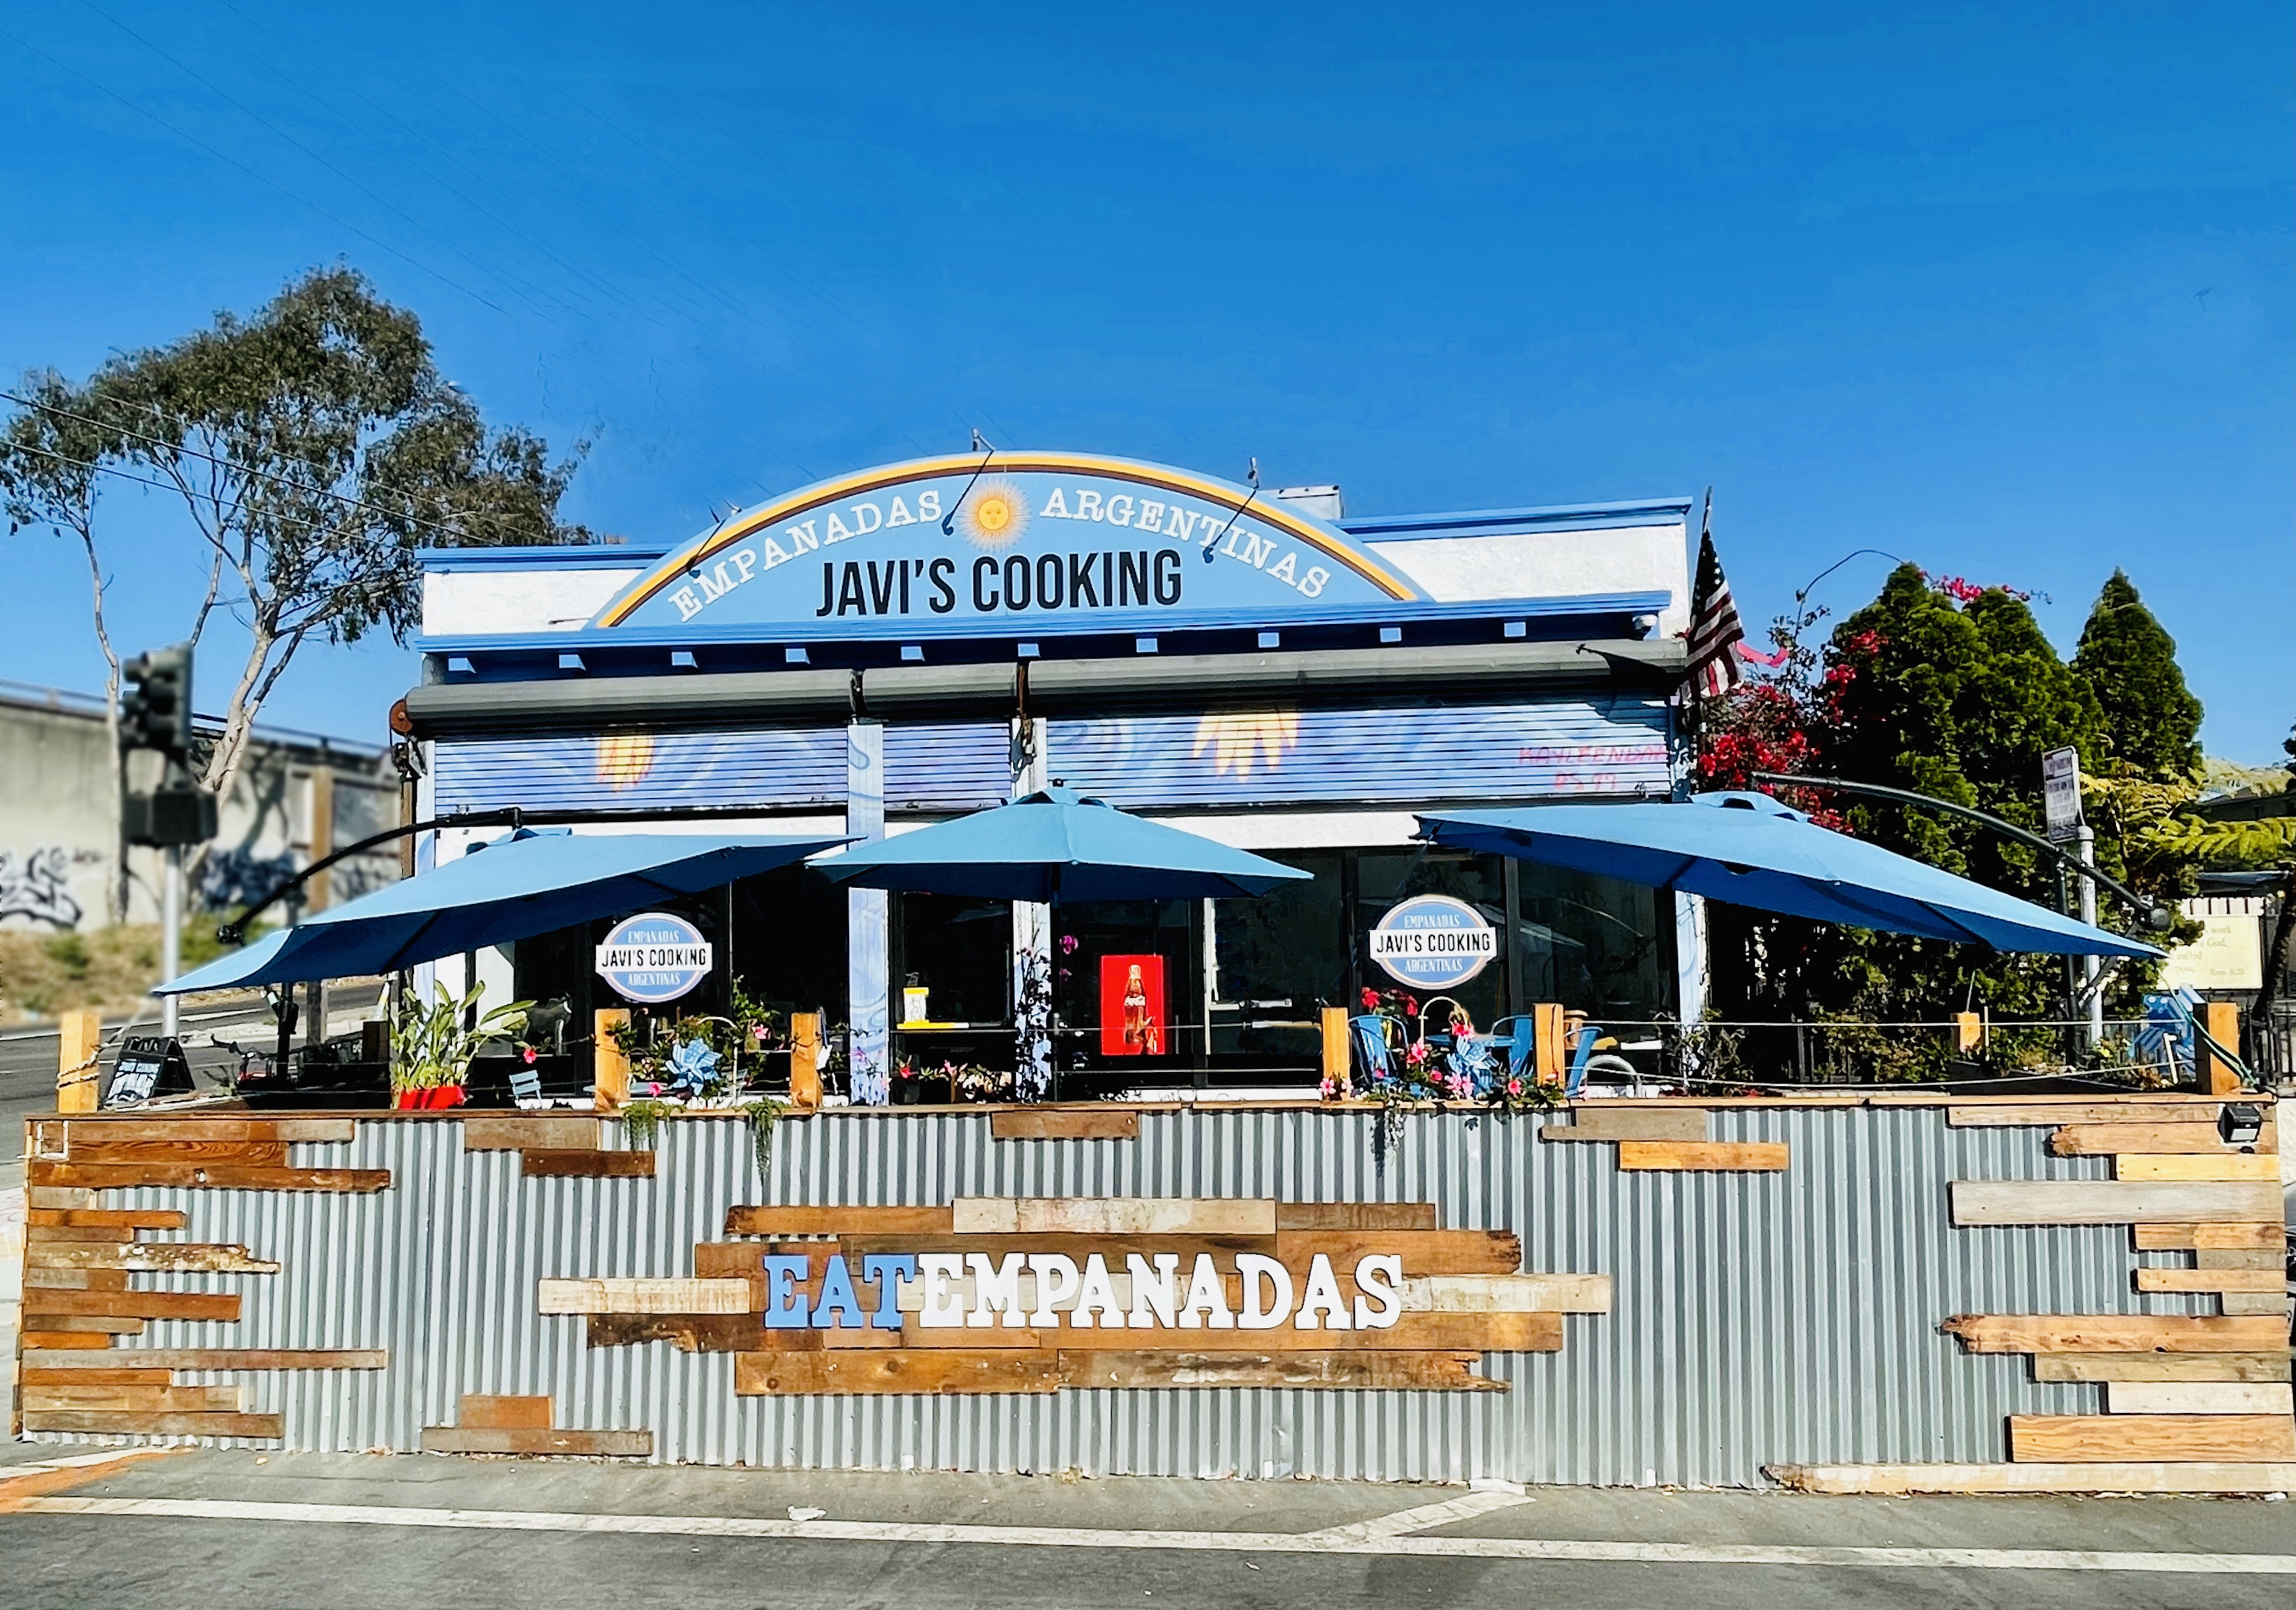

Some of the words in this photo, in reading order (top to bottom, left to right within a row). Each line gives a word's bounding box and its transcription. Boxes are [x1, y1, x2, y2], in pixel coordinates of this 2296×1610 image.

[668, 490, 942, 623] EMPANADAS
[1039, 488, 1331, 599] ARGENTINAS
[816, 558, 956, 617] JAVI'S
[973, 549, 1182, 612] COOKING
[1404, 915, 1460, 928] EMPANADAS
[627, 930, 679, 944] EMPANADAS
[1376, 934, 1422, 952] JAVI'S
[1428, 933, 1490, 952] COOKING
[602, 949, 644, 967] JAVI'S
[650, 948, 706, 966] COOKING
[1405, 959, 1463, 973] ARGENTINAS
[627, 973, 680, 986] ARGENTINAS
